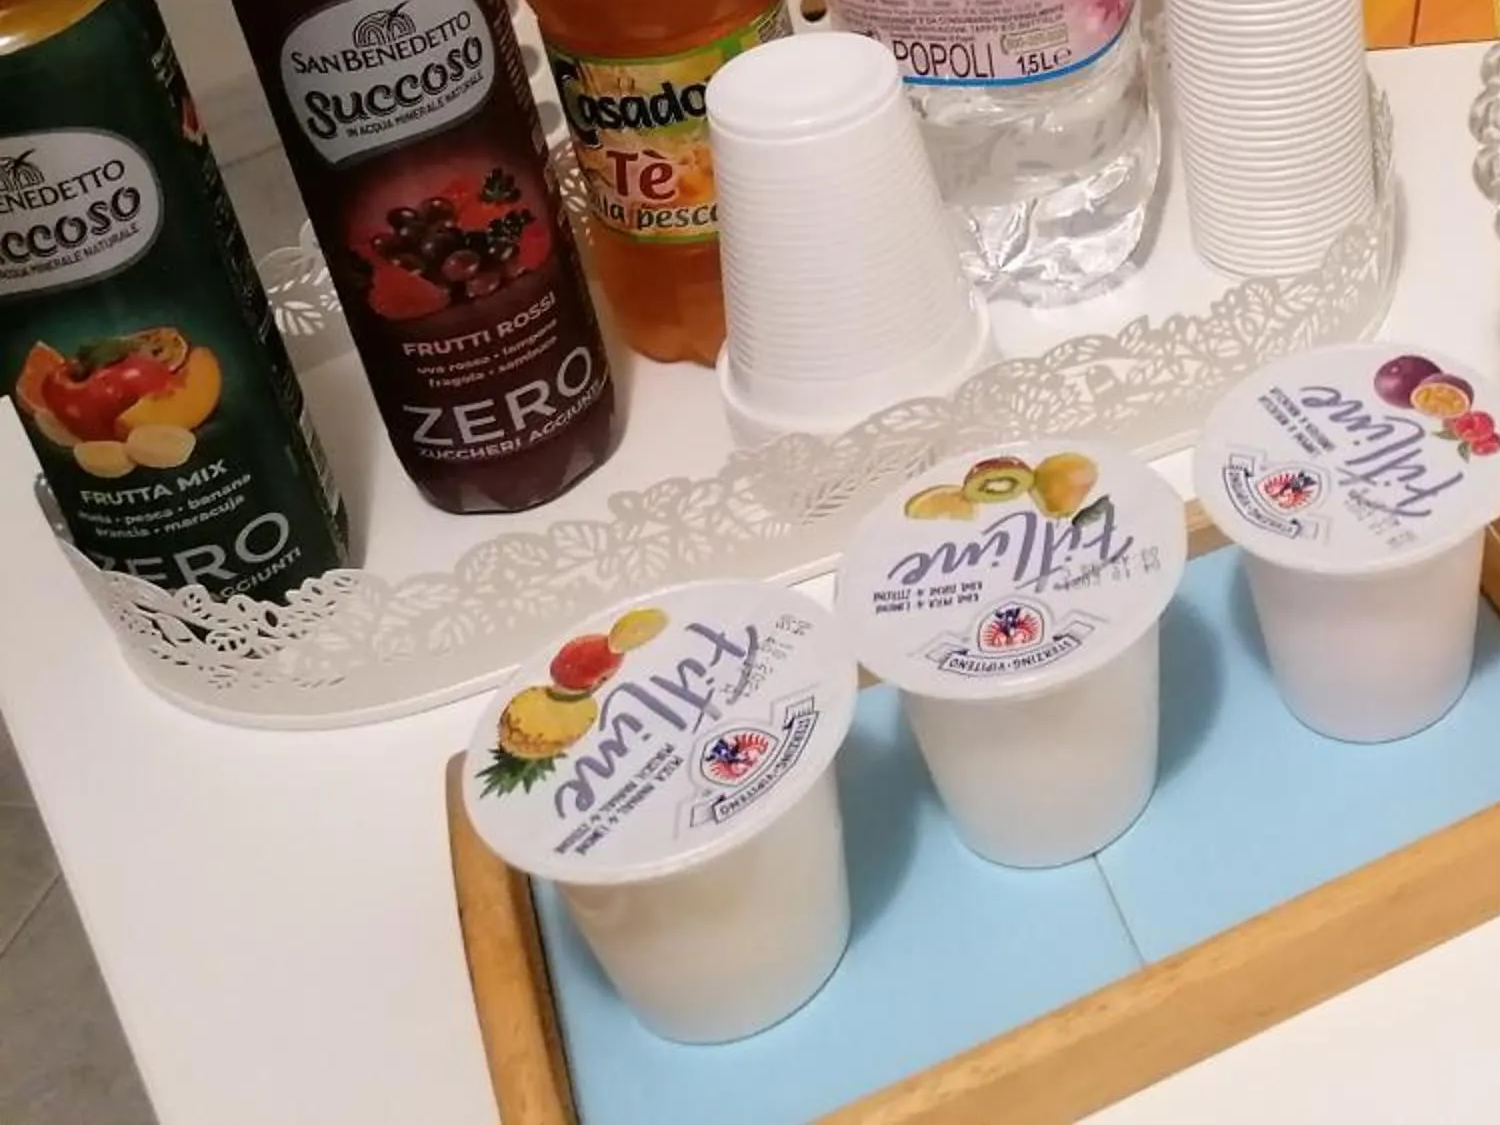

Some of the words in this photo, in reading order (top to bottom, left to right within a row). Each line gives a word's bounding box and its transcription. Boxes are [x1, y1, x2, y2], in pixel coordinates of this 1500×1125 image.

[342, 11, 472, 72] BENEDETTO
[893, 40, 995, 78] POPOLI
[0, 159, 126, 215] ENEDETTO
[605, 148, 677, 201] Tè
[596, 195, 626, 222] lla
[403, 330, 493, 357] FRUTTI
[497, 291, 557, 338] ROSSI
[402, 345, 593, 446] ZERO
[419, 437, 522, 460] ZUCCHERI
[79, 483, 174, 508] FRUTTA
[176, 458, 230, 493] MIX
[186, 474, 252, 512] banana
